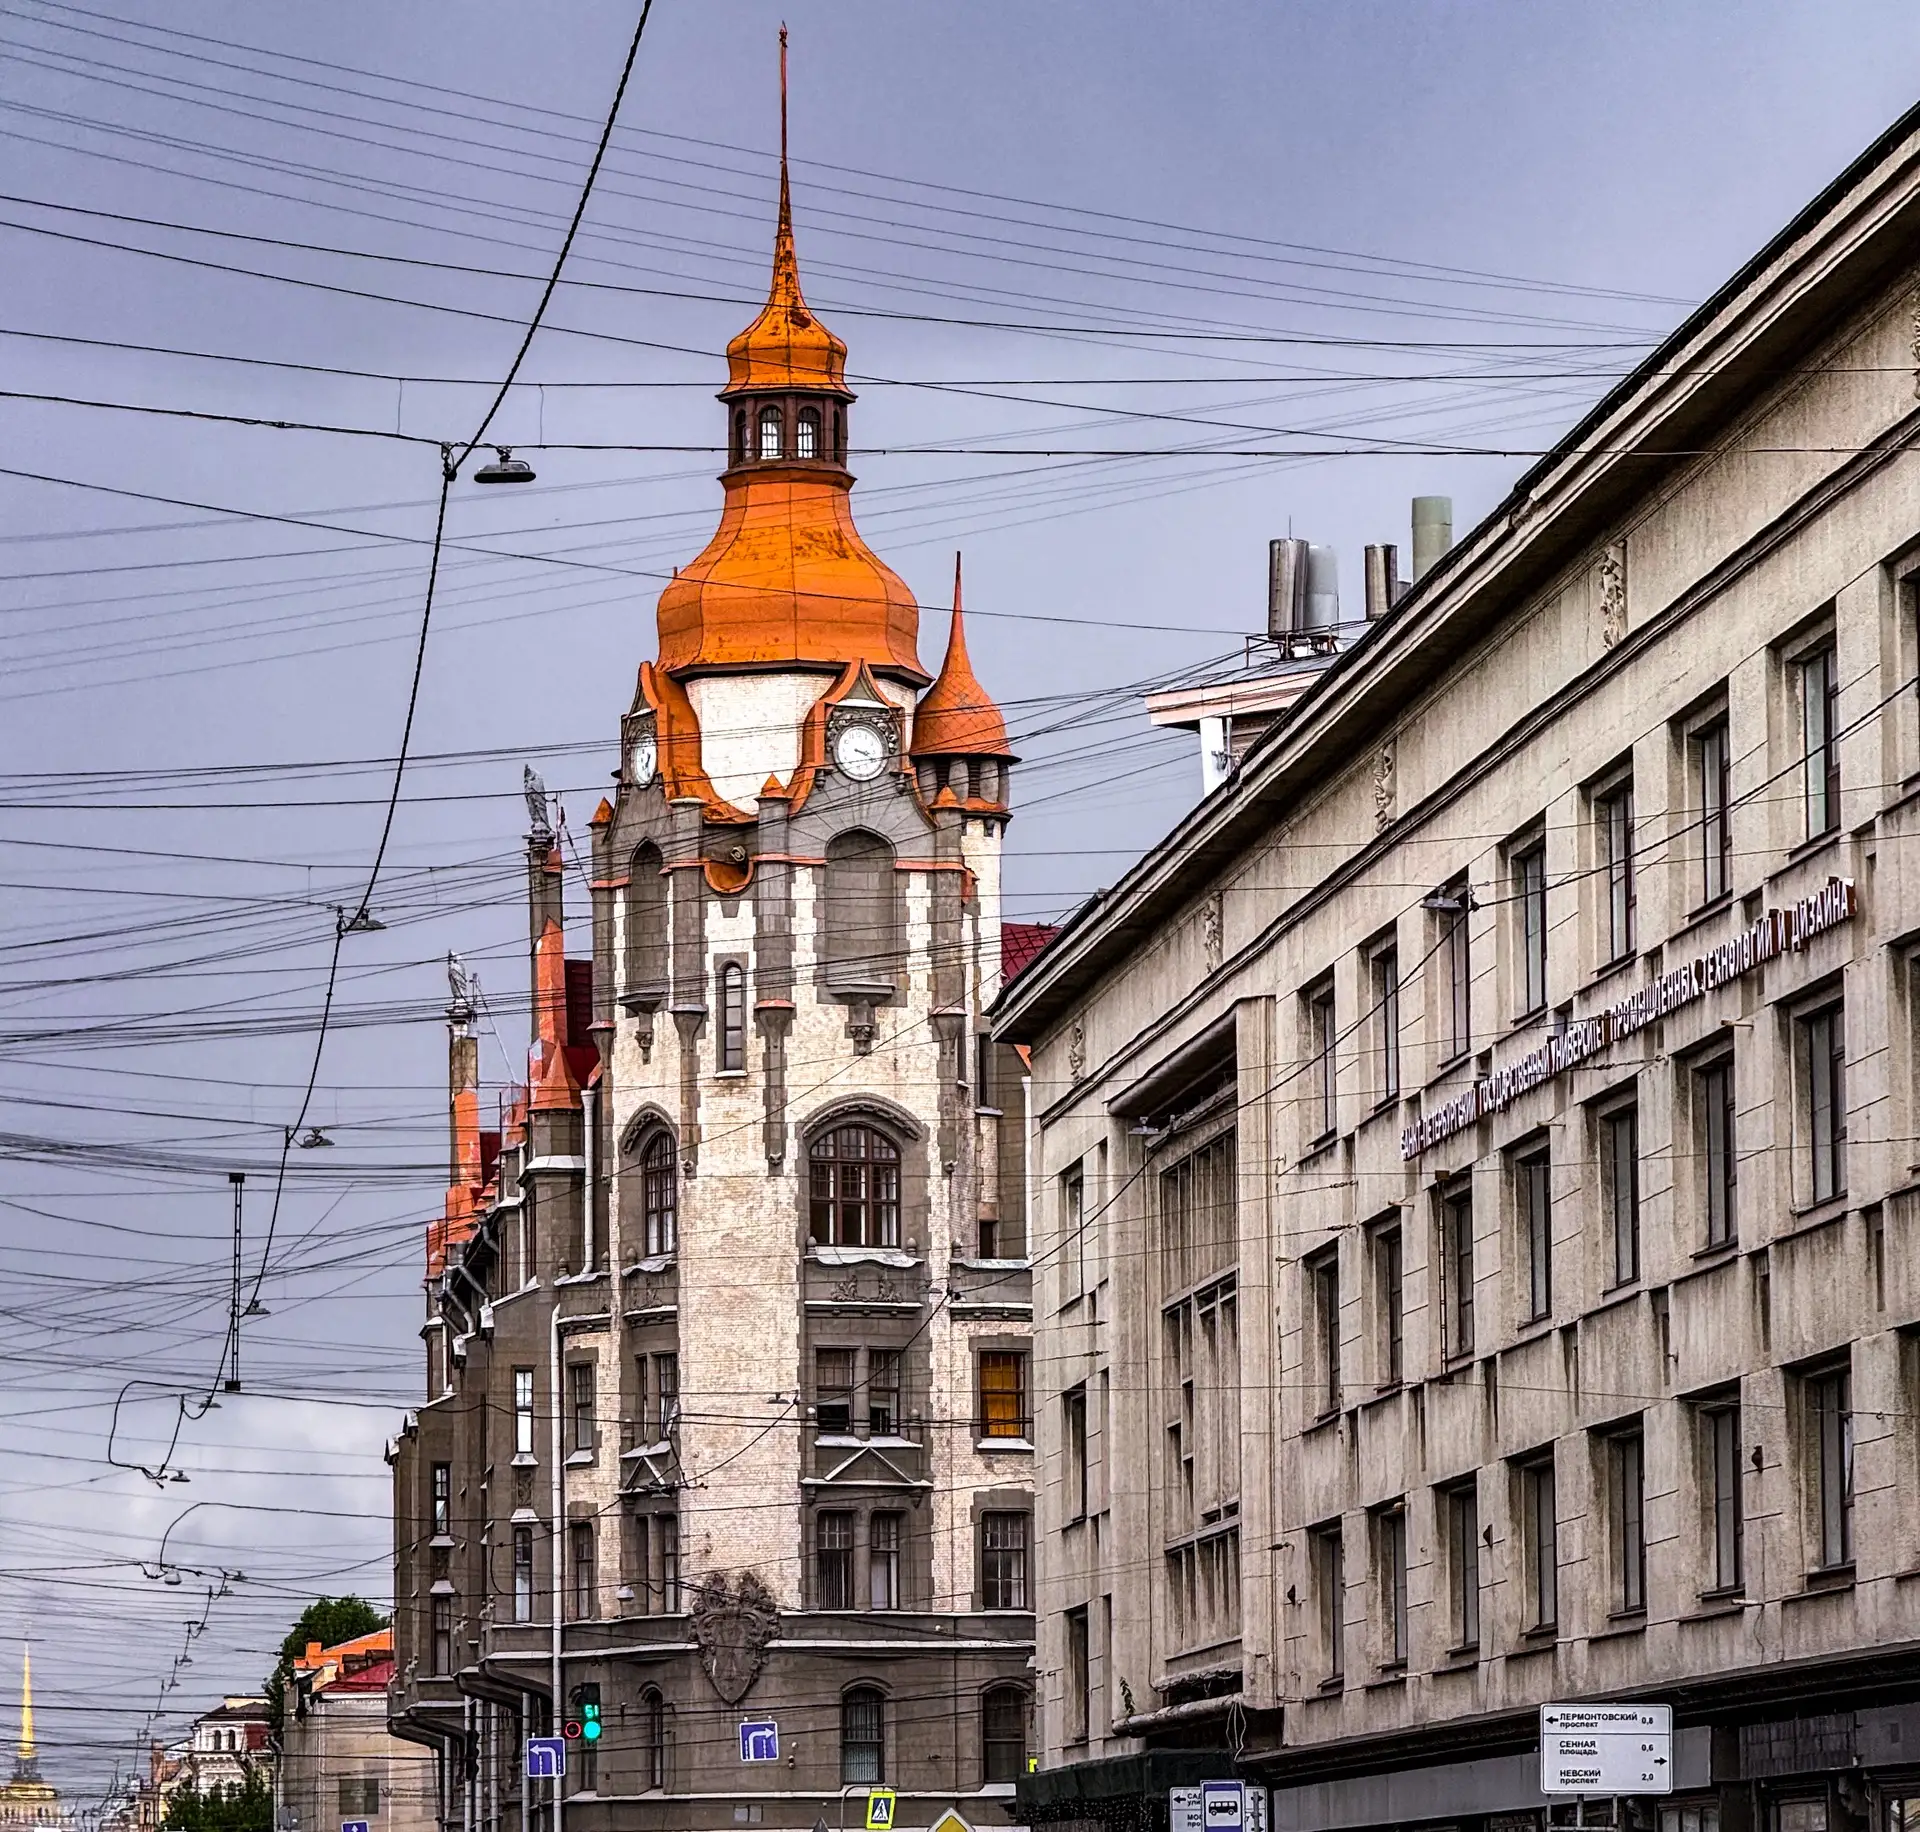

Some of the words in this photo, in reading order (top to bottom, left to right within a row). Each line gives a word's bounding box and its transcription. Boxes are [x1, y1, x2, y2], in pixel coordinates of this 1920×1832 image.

[1560, 1712, 1638, 1721] ЛЕРМОНТОВСКИЙ
[1641, 1717, 1654, 1725] 0,8
[1560, 1740, 1596, 1748] СЕННАЯ
[1641, 1744, 1654, 1752] 0,6
[1560, 1768, 1601, 1777] НЕВСКИЙ
[1641, 1773, 1654, 1781] 2,0
